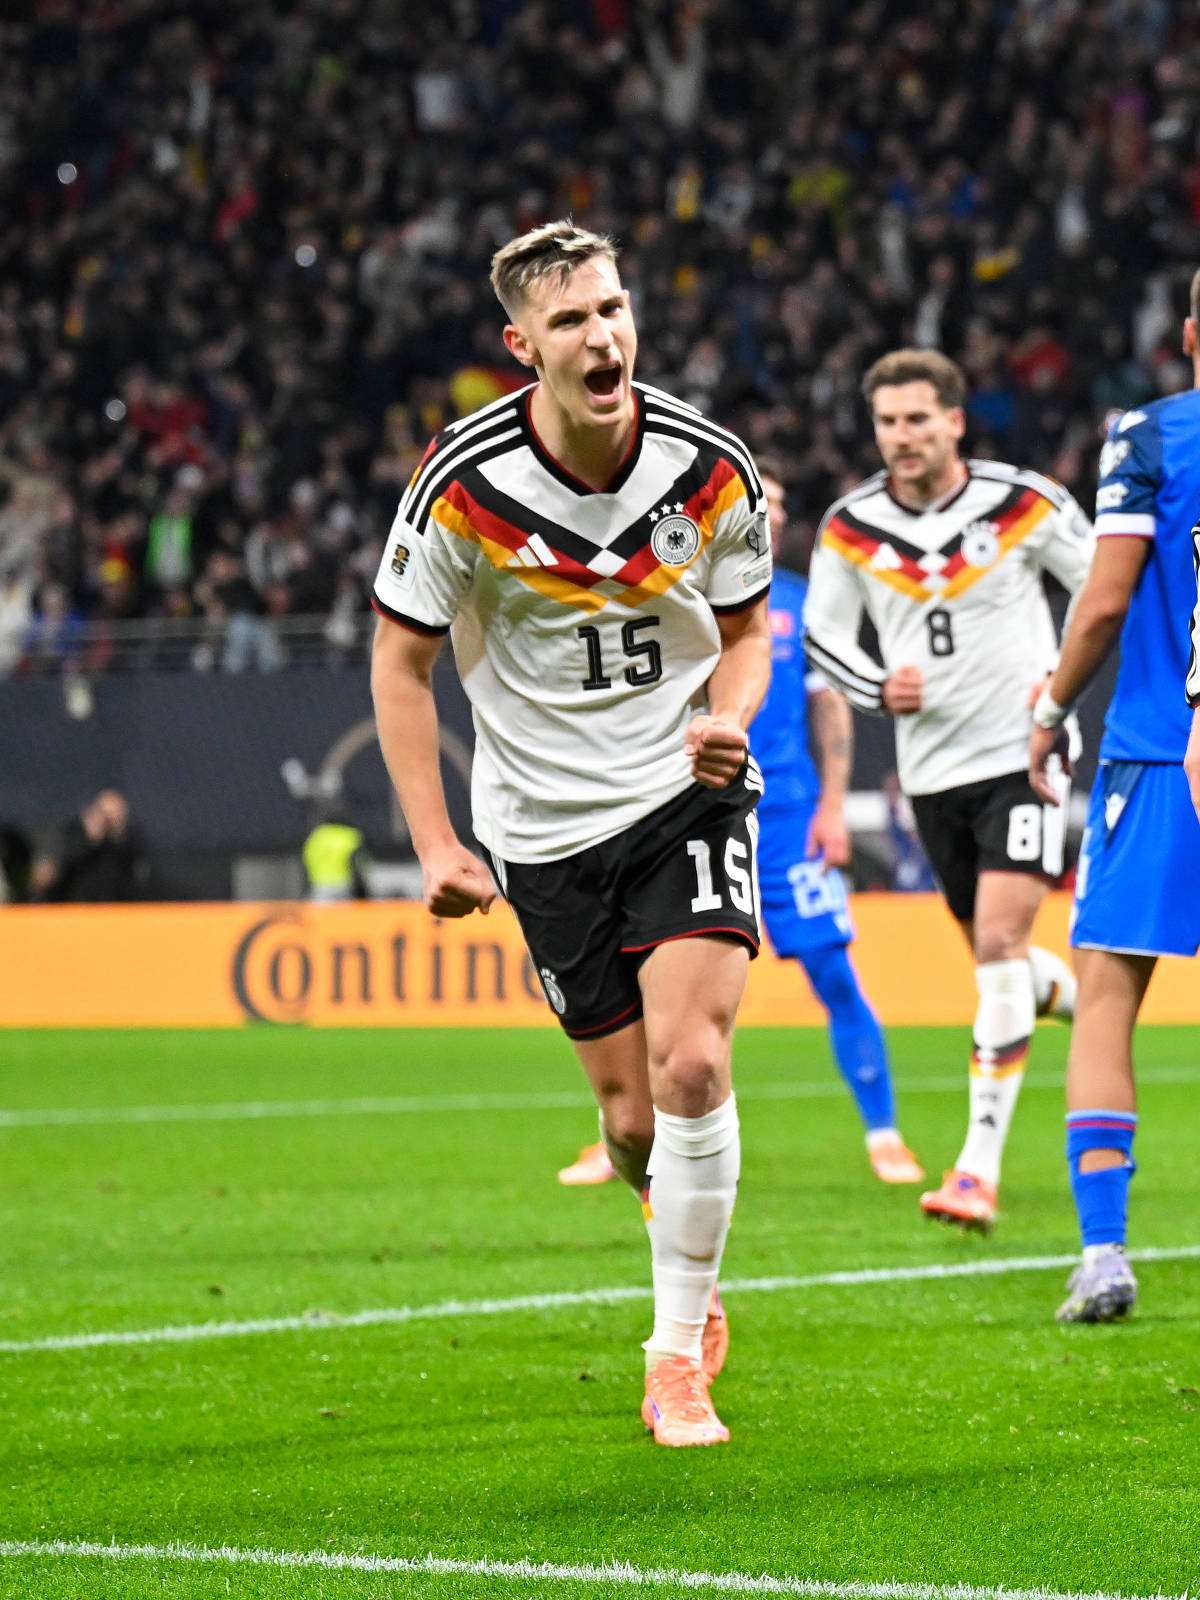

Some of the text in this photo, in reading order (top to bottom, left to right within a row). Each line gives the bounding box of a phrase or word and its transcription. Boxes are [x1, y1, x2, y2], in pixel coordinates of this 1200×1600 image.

[578, 616, 663, 691] 15
[926, 610, 955, 656] 8
[1007, 804, 1040, 861] 8
[687, 837, 753, 915] 15
